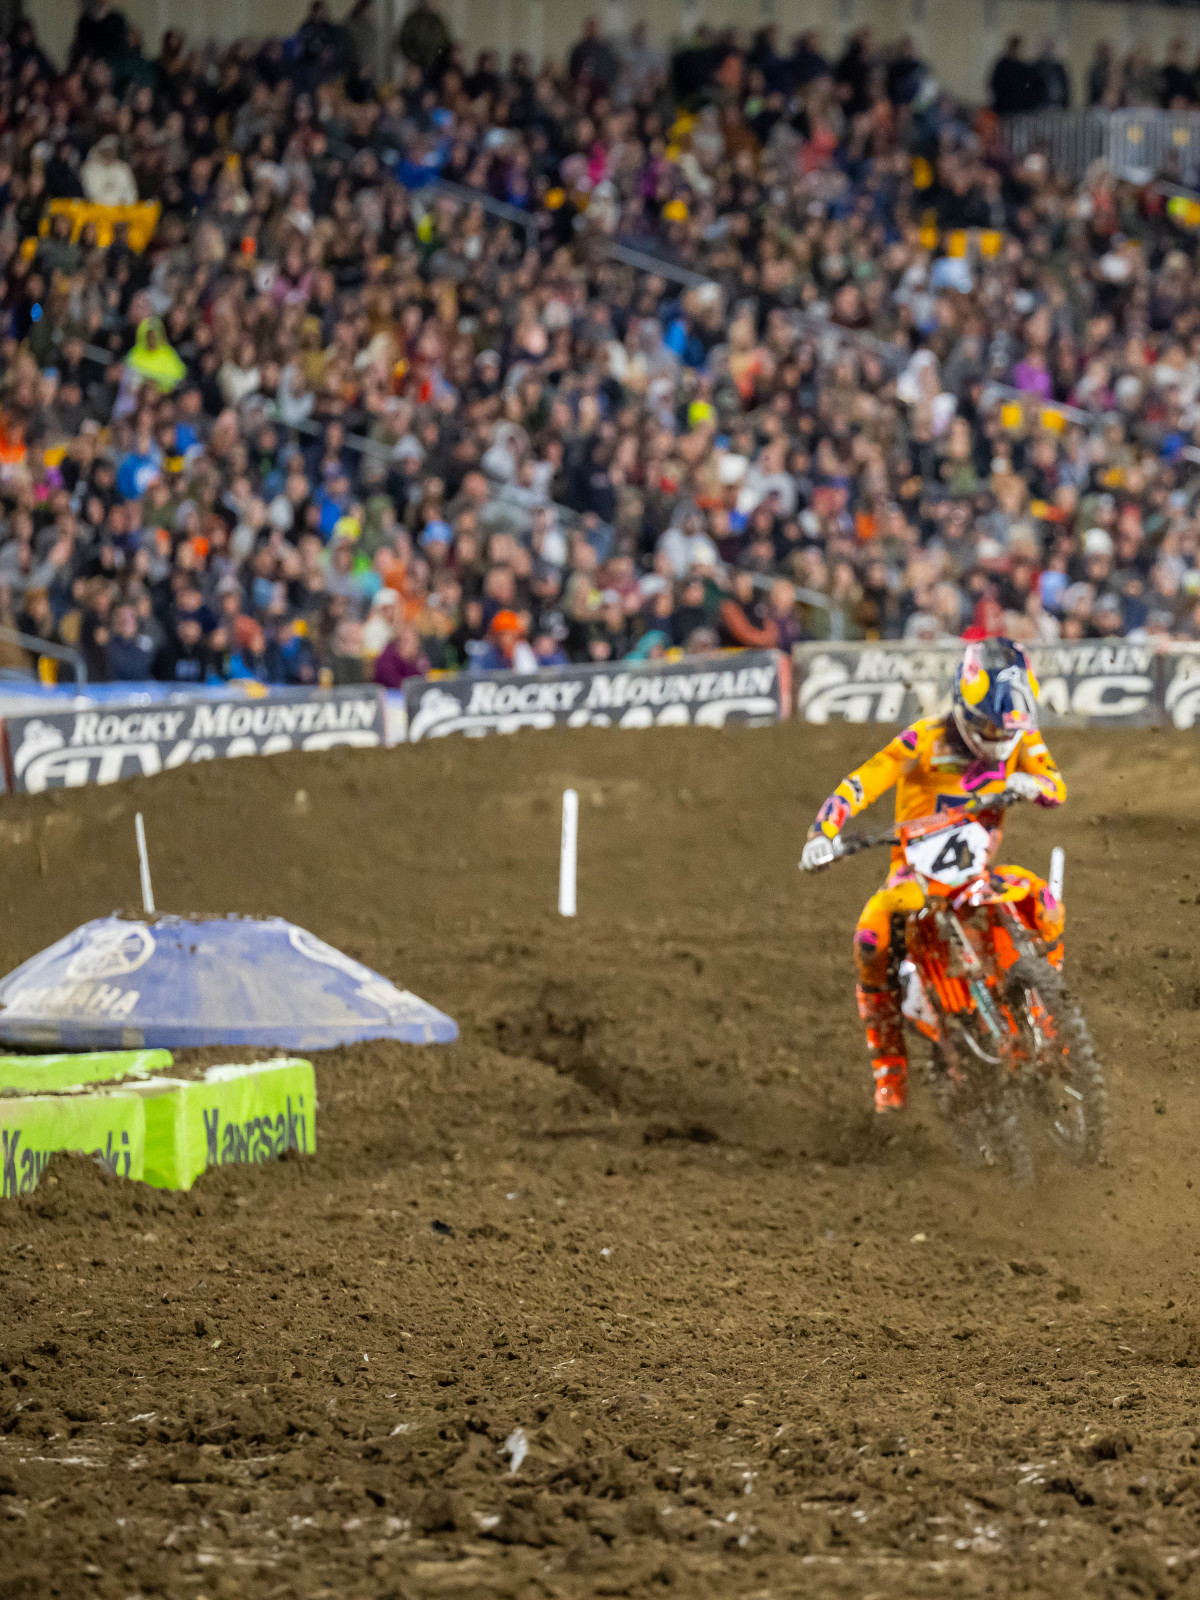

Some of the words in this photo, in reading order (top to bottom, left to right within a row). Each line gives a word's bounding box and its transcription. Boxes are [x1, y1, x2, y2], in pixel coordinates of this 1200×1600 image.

[1036, 649, 1156, 673] UNTAIN
[466, 681, 583, 715] ROCKY
[586, 665, 777, 710] MOUNTAIN
[71, 711, 185, 746] ROCKY
[189, 700, 377, 739] MOUNTAIN
[931, 832, 975, 874] 4
[203, 1095, 307, 1166] Kawasaki
[2, 1129, 132, 1199] Kawki
